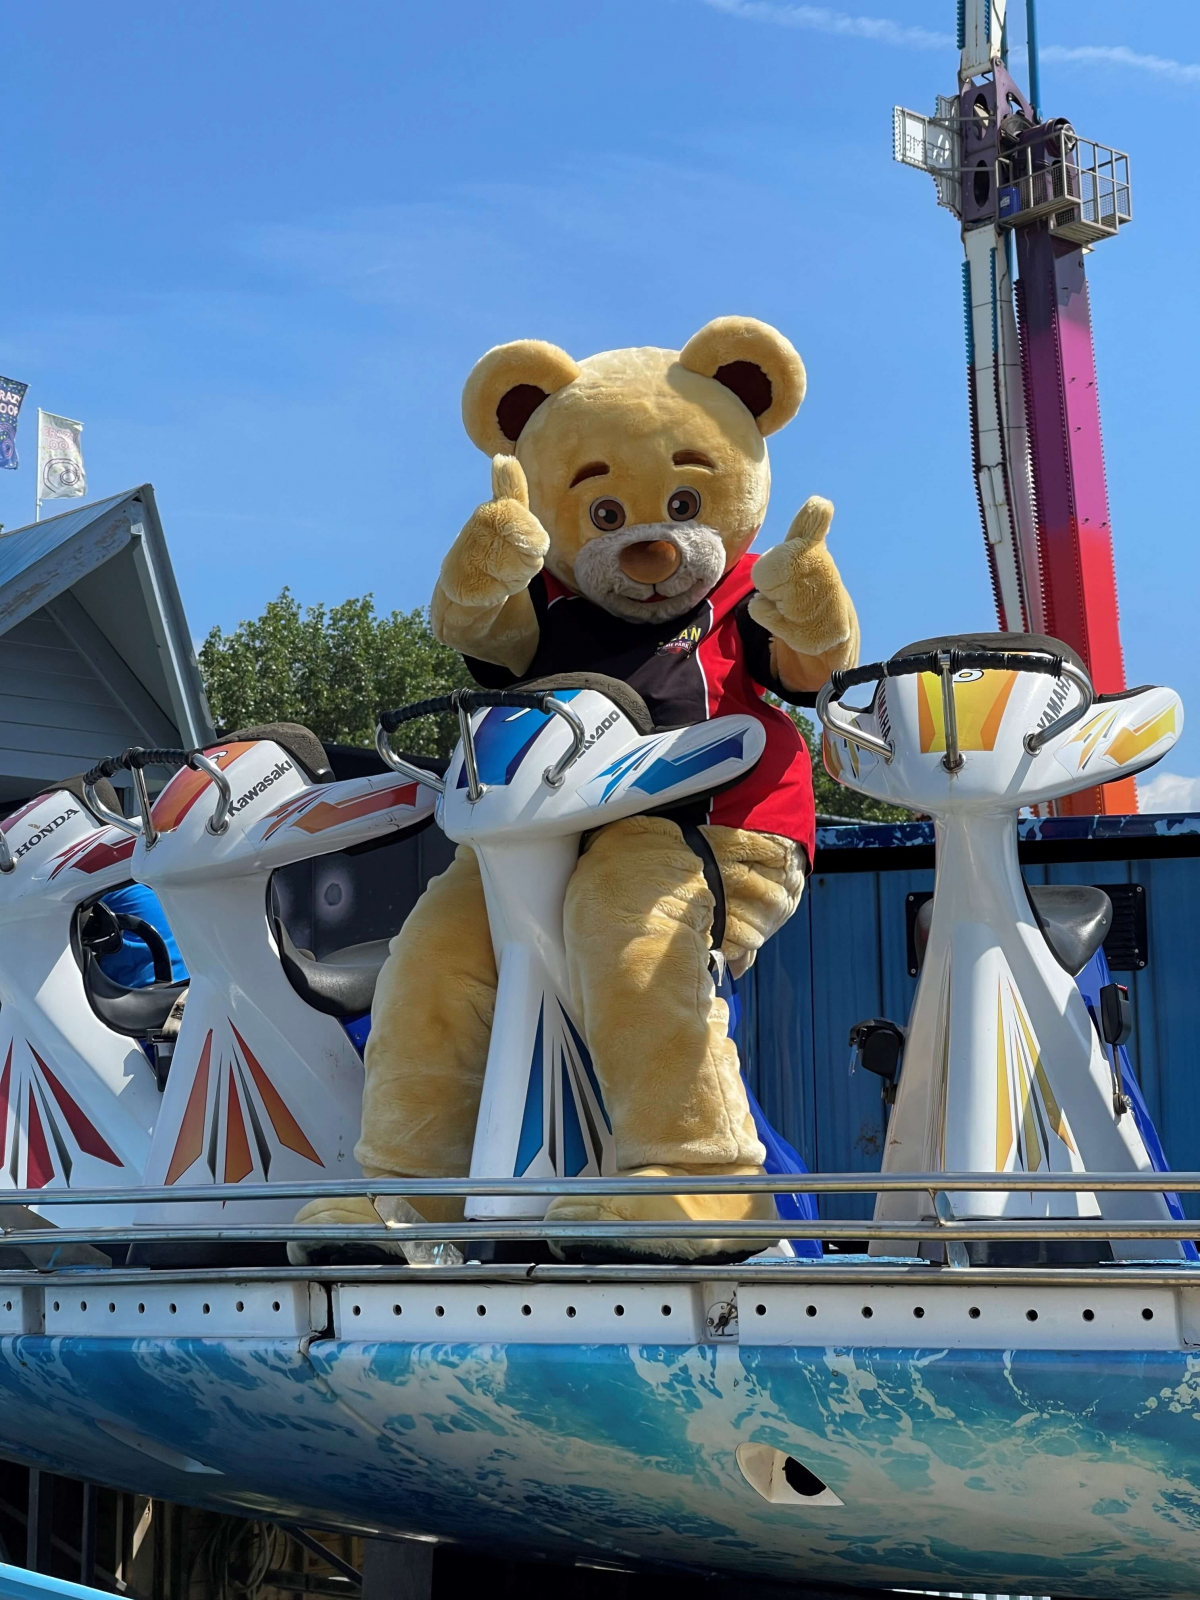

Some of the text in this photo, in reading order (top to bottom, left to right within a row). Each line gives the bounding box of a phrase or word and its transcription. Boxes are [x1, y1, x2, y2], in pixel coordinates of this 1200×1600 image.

[672, 626, 702, 642] AN
[227, 760, 293, 817] Kawasaki
[14, 808, 80, 858] HONDA
